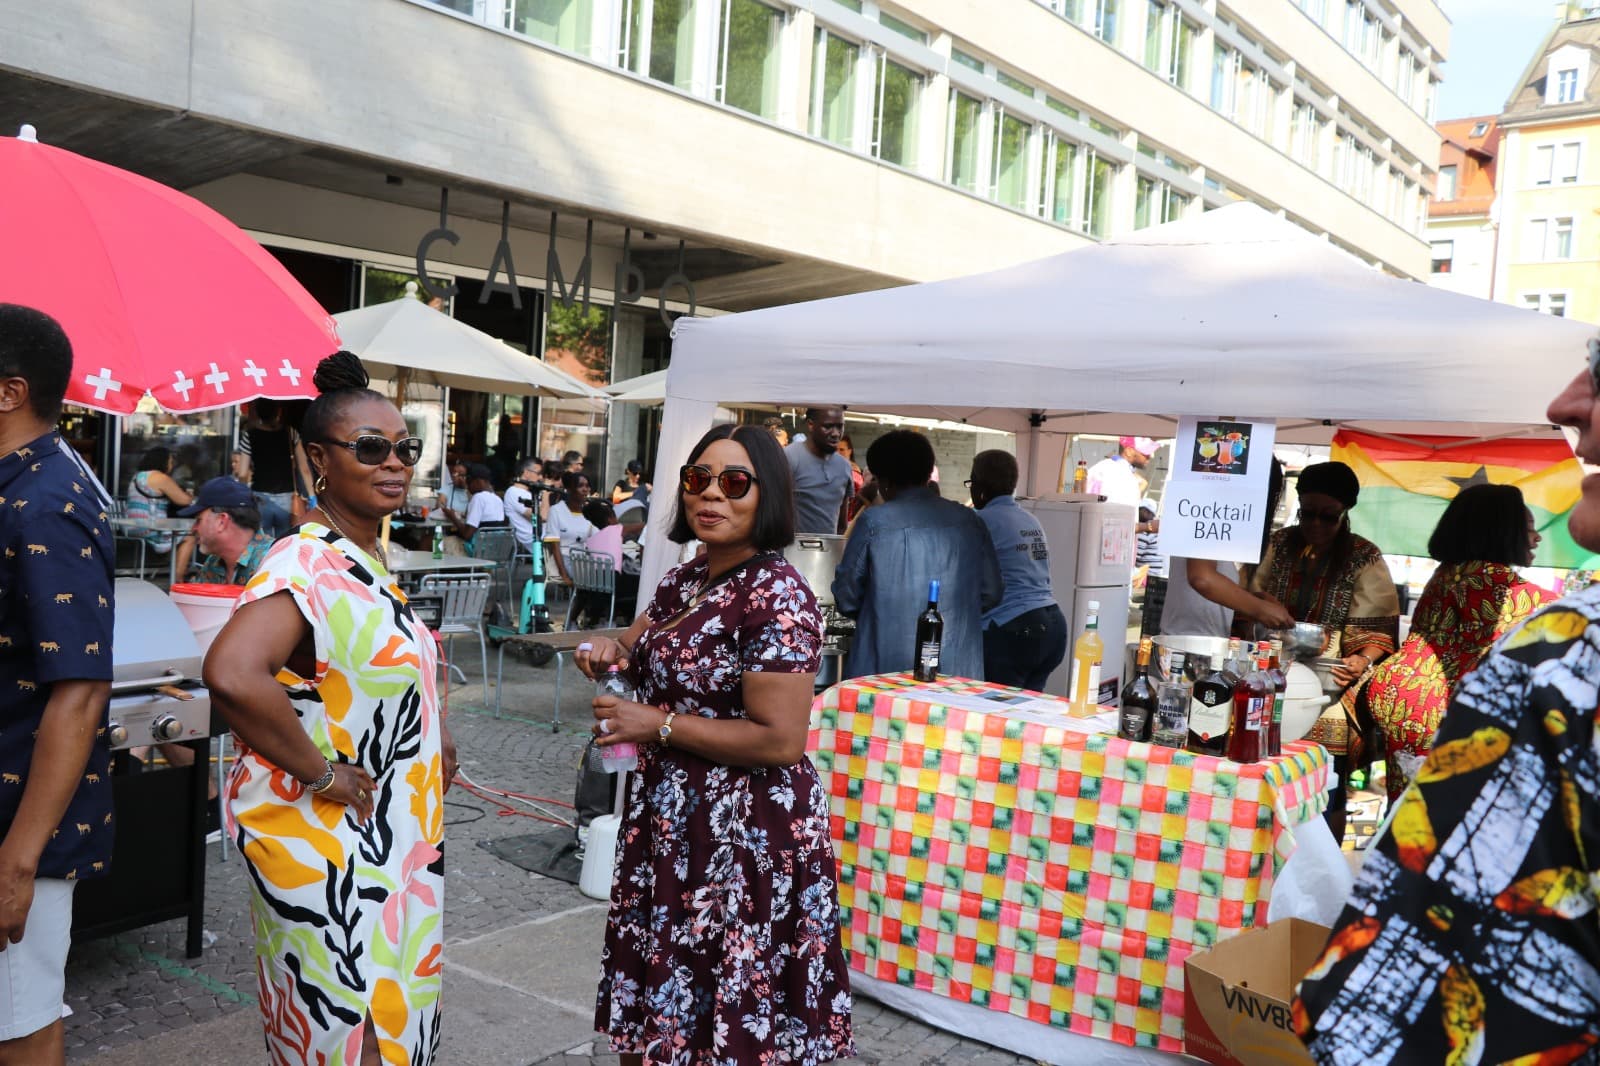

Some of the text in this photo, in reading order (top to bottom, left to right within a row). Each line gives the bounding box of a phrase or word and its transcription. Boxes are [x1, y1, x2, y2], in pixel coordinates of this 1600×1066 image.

[416, 227, 696, 330] CAMPO
[1178, 498, 1252, 522] Cocktail
[1194, 521, 1232, 541] BAR
